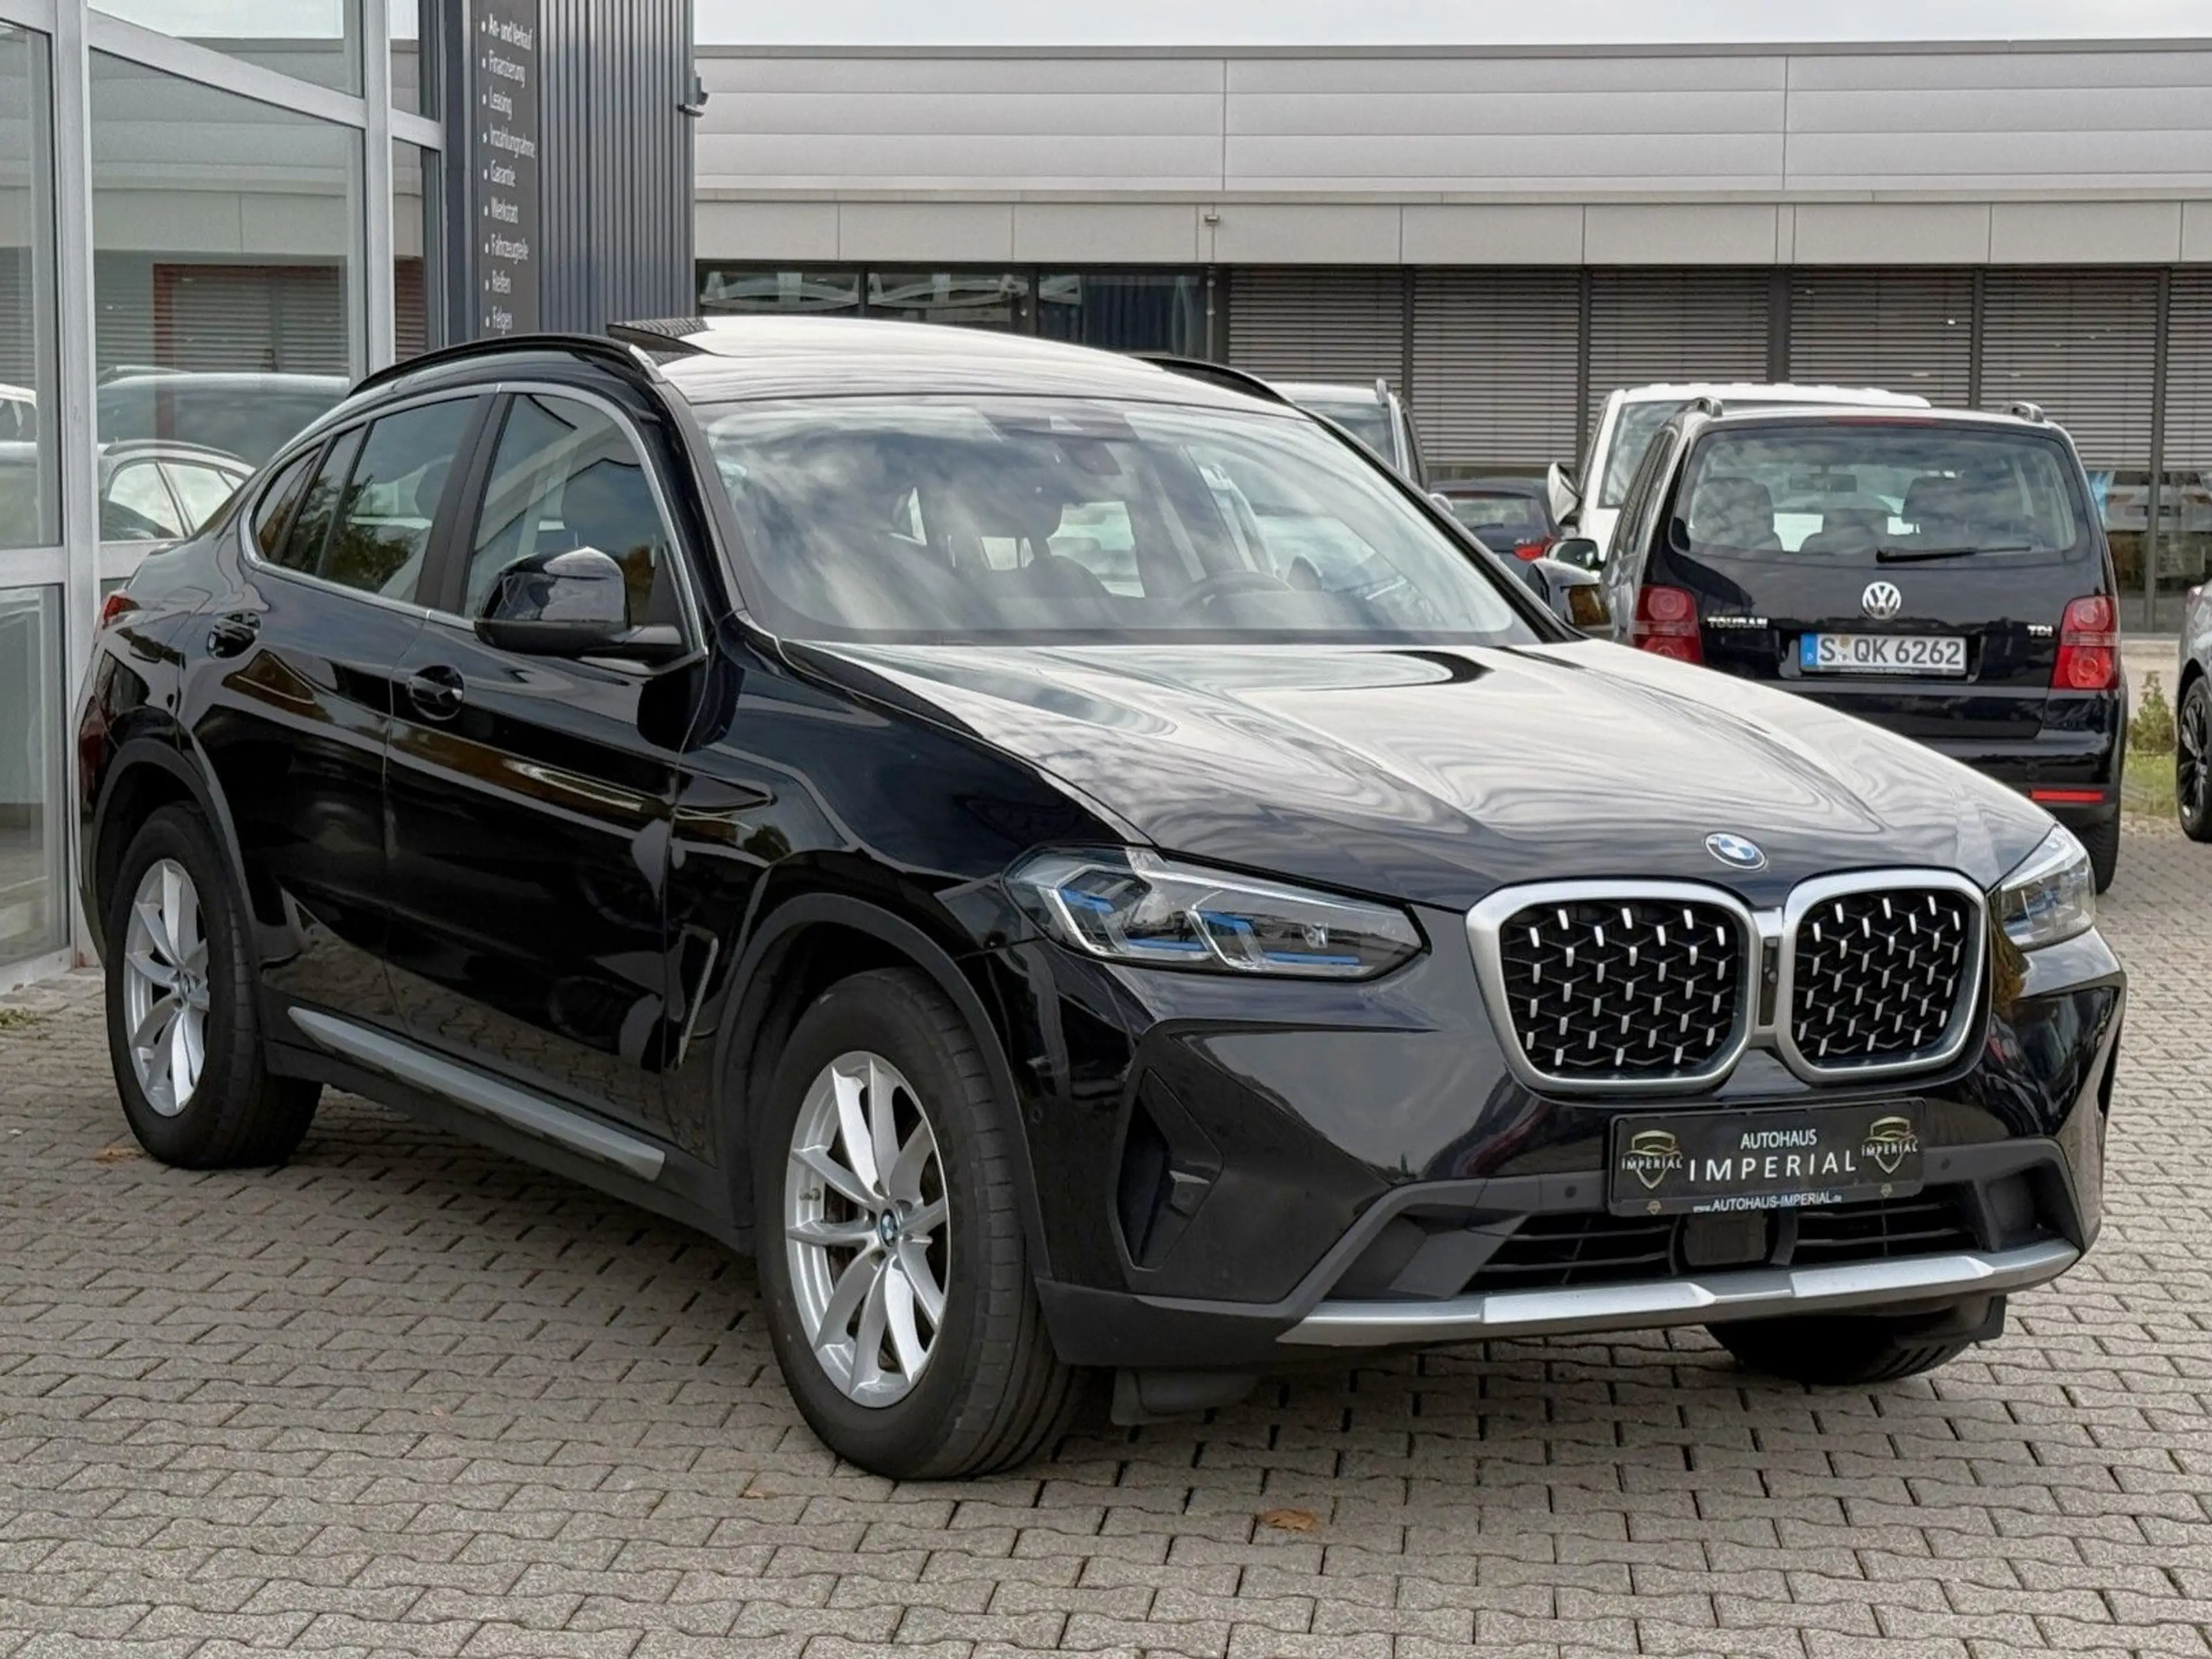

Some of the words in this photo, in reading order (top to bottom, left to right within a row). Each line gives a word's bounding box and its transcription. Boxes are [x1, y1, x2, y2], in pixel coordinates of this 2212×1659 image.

[1820, 637, 1836, 662] S
[1854, 638, 1888, 664] QK
[1895, 639, 1961, 665] 6262
[1740, 1129, 1817, 1150] AUTOHAUS
[1622, 1155, 1683, 1170] IMPERIAL
[1688, 1150, 1857, 1181] IMPERIAL
